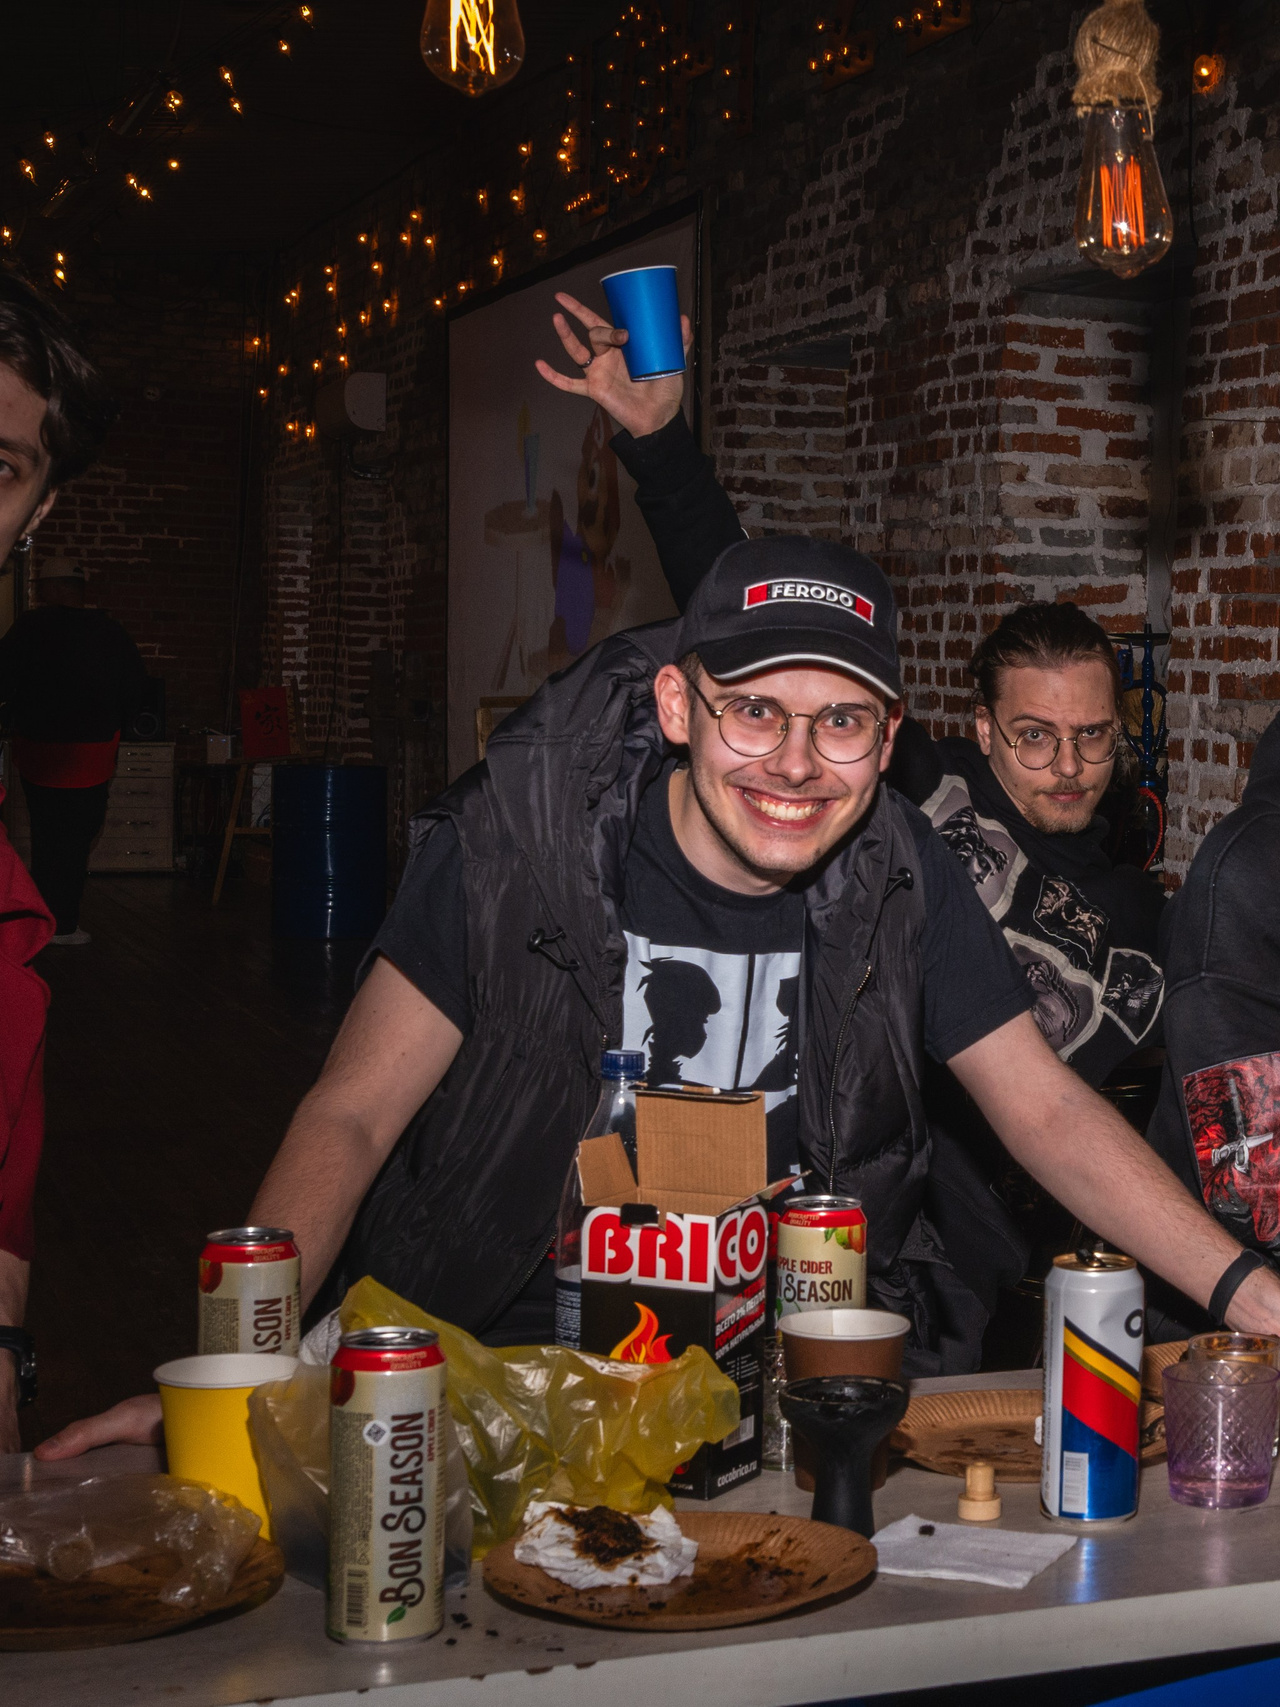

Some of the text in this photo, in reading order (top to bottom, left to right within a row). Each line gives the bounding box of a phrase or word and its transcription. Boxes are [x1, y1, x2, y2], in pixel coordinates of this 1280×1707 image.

[771, 583, 853, 607] FERODO
[585, 1207, 767, 1287] BRICO
[777, 1256, 832, 1274] PPLE CIDER
[783, 1273, 853, 1303] SEASON
[715, 1312, 736, 1337] ВСЕГО
[735, 1305, 746, 1321] 2%
[717, 1460, 758, 1488] cocobrico.ru
[379, 1411, 426, 1607] BON SEASON
